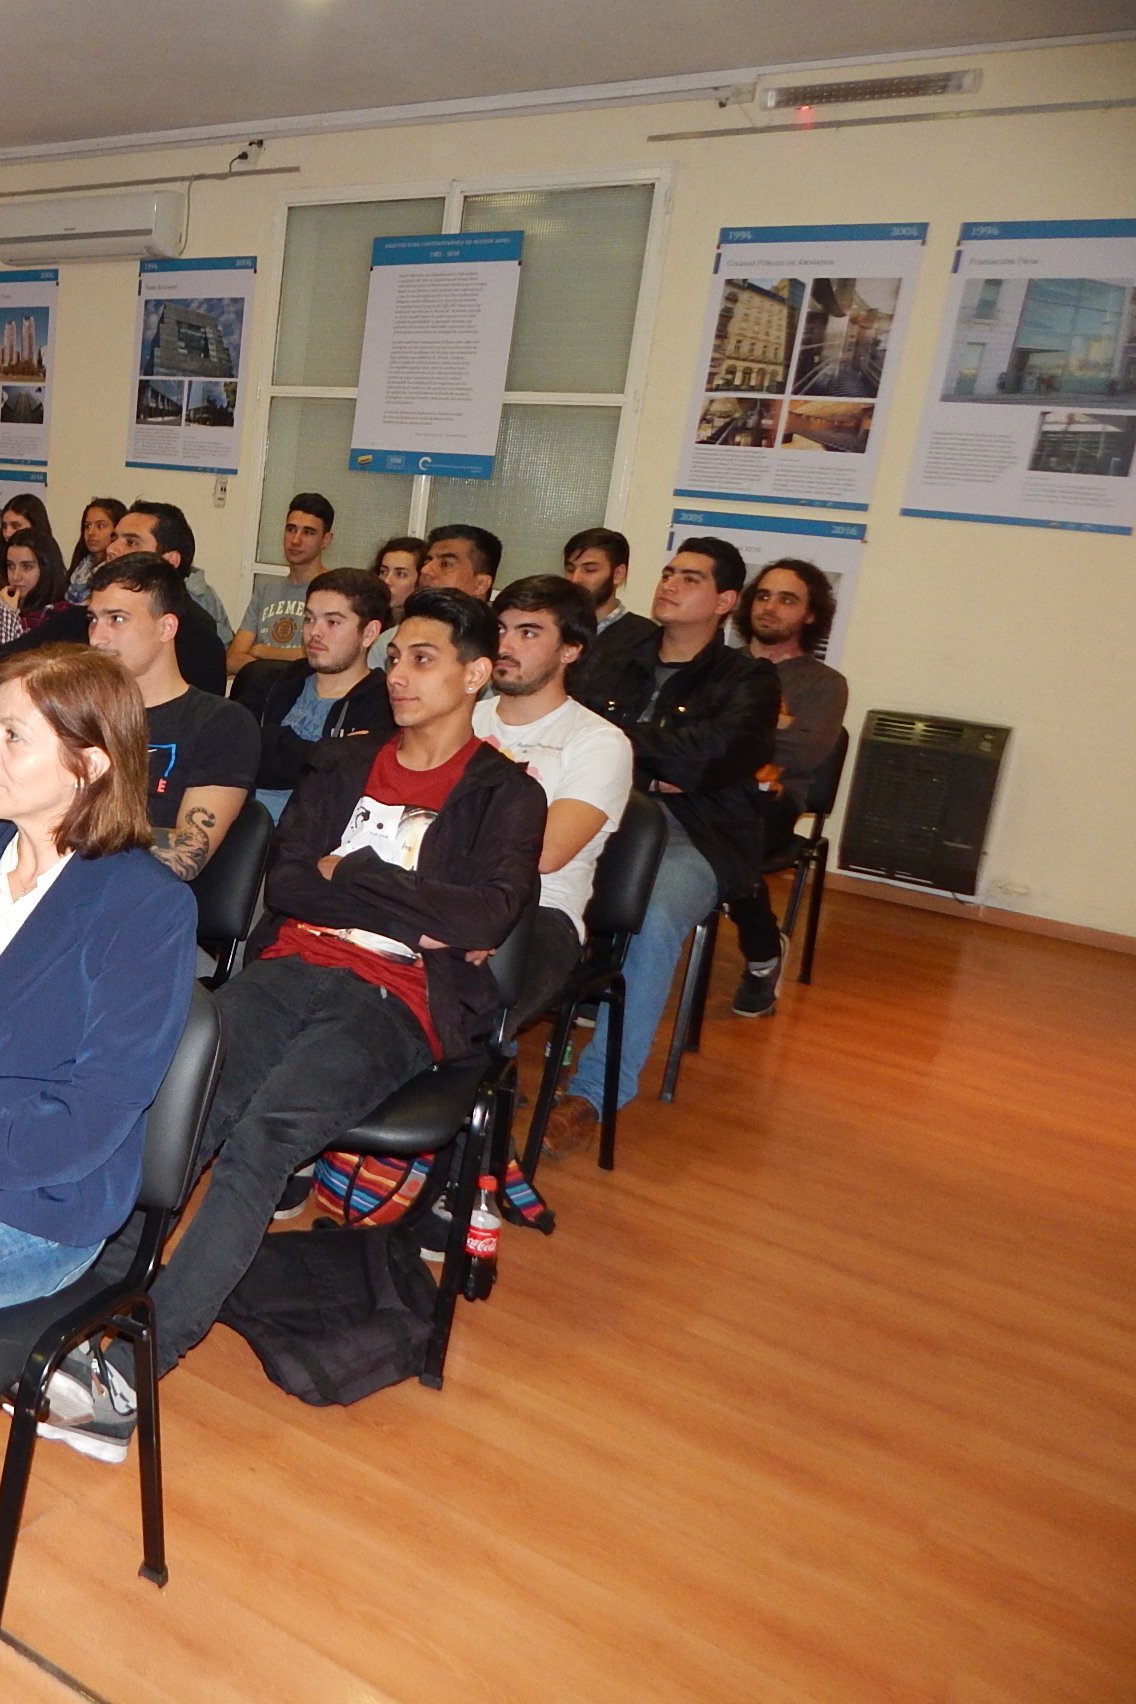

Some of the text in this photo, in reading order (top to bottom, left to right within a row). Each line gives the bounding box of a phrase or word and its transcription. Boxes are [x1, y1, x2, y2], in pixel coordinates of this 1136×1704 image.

[728, 230, 752, 241] 1994
[679, 512, 703, 523] 2005
[831, 525, 857, 536] 2016
[261, 600, 306, 622] ELEME
